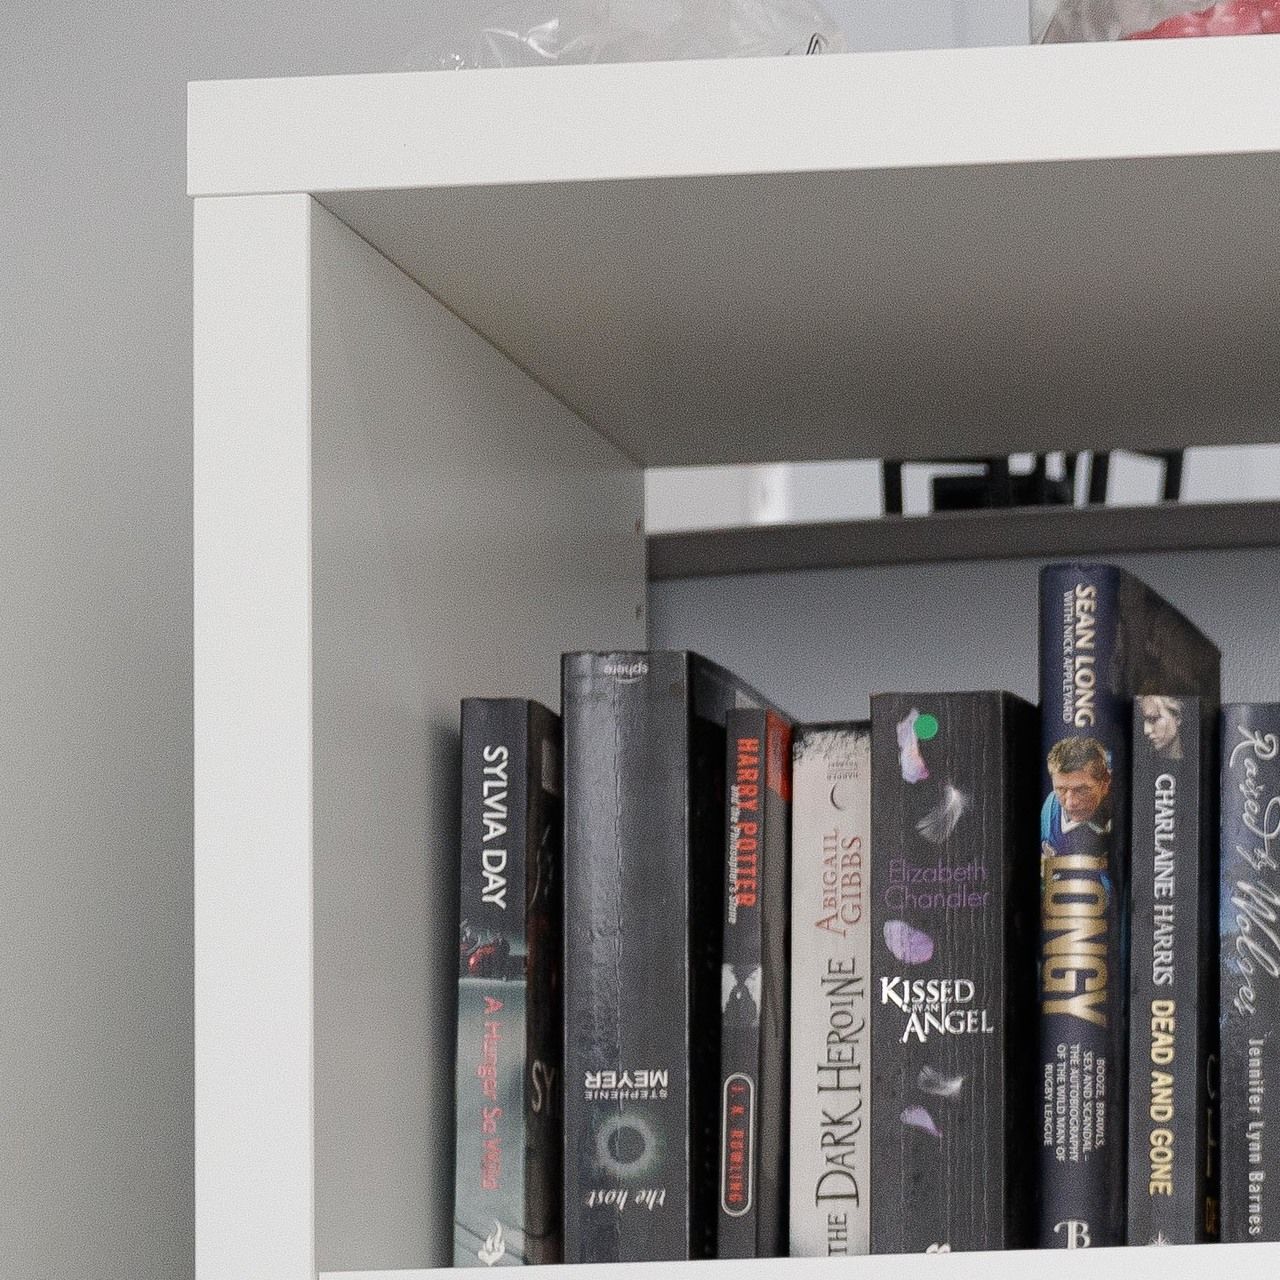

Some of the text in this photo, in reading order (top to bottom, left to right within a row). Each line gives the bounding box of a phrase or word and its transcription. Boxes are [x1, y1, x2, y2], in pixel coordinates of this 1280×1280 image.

[603, 661, 649, 677] sphere
[1063, 590, 1073, 724] WITH NICK APPLEYARD
[1075, 583, 1097, 728] SEAN LONG
[481, 745, 509, 910] SYLVIA DAY
[736, 737, 759, 907] HARRY POTTER
[815, 829, 846, 938] ABIGAIL
[841, 837, 861, 926] GIBBS
[884, 884, 991, 910] Chandler
[888, 858, 989, 883] Elizabeth
[1153, 773, 1176, 986] CHARLAINE HARRIS
[1042, 854, 1108, 1028] LONGY
[484, 996, 505, 1014] A
[880, 977, 975, 1013] KISSED
[899, 1003, 994, 1043] ANGEL
[476, 1021, 503, 1102] Hunger
[584, 1069, 669, 1089] MEYER
[584, 1089, 669, 1101] STEPHENIE
[1083, 1050, 1093, 1071] SEX
[1083, 1074, 1093, 1098] AND
[1149, 1000, 1176, 1197] DEAD AND GONE
[481, 1106, 504, 1134] So
[816, 957, 865, 1256] THE DARK HEROINE
[1044, 1063, 1053, 1146] RUGBY LEAGUE
[1056, 1044, 1067, 1162] OF THE WILD MAN OF
[1069, 1044, 1079, 1162] THE AUTOBIOGRAPHY
[1083, 1100, 1092, 1152] SCANDAL
[1245, 1039, 1265, 1235] Jennifer Lynn Barnes
[587, 1188, 666, 1211] the host
